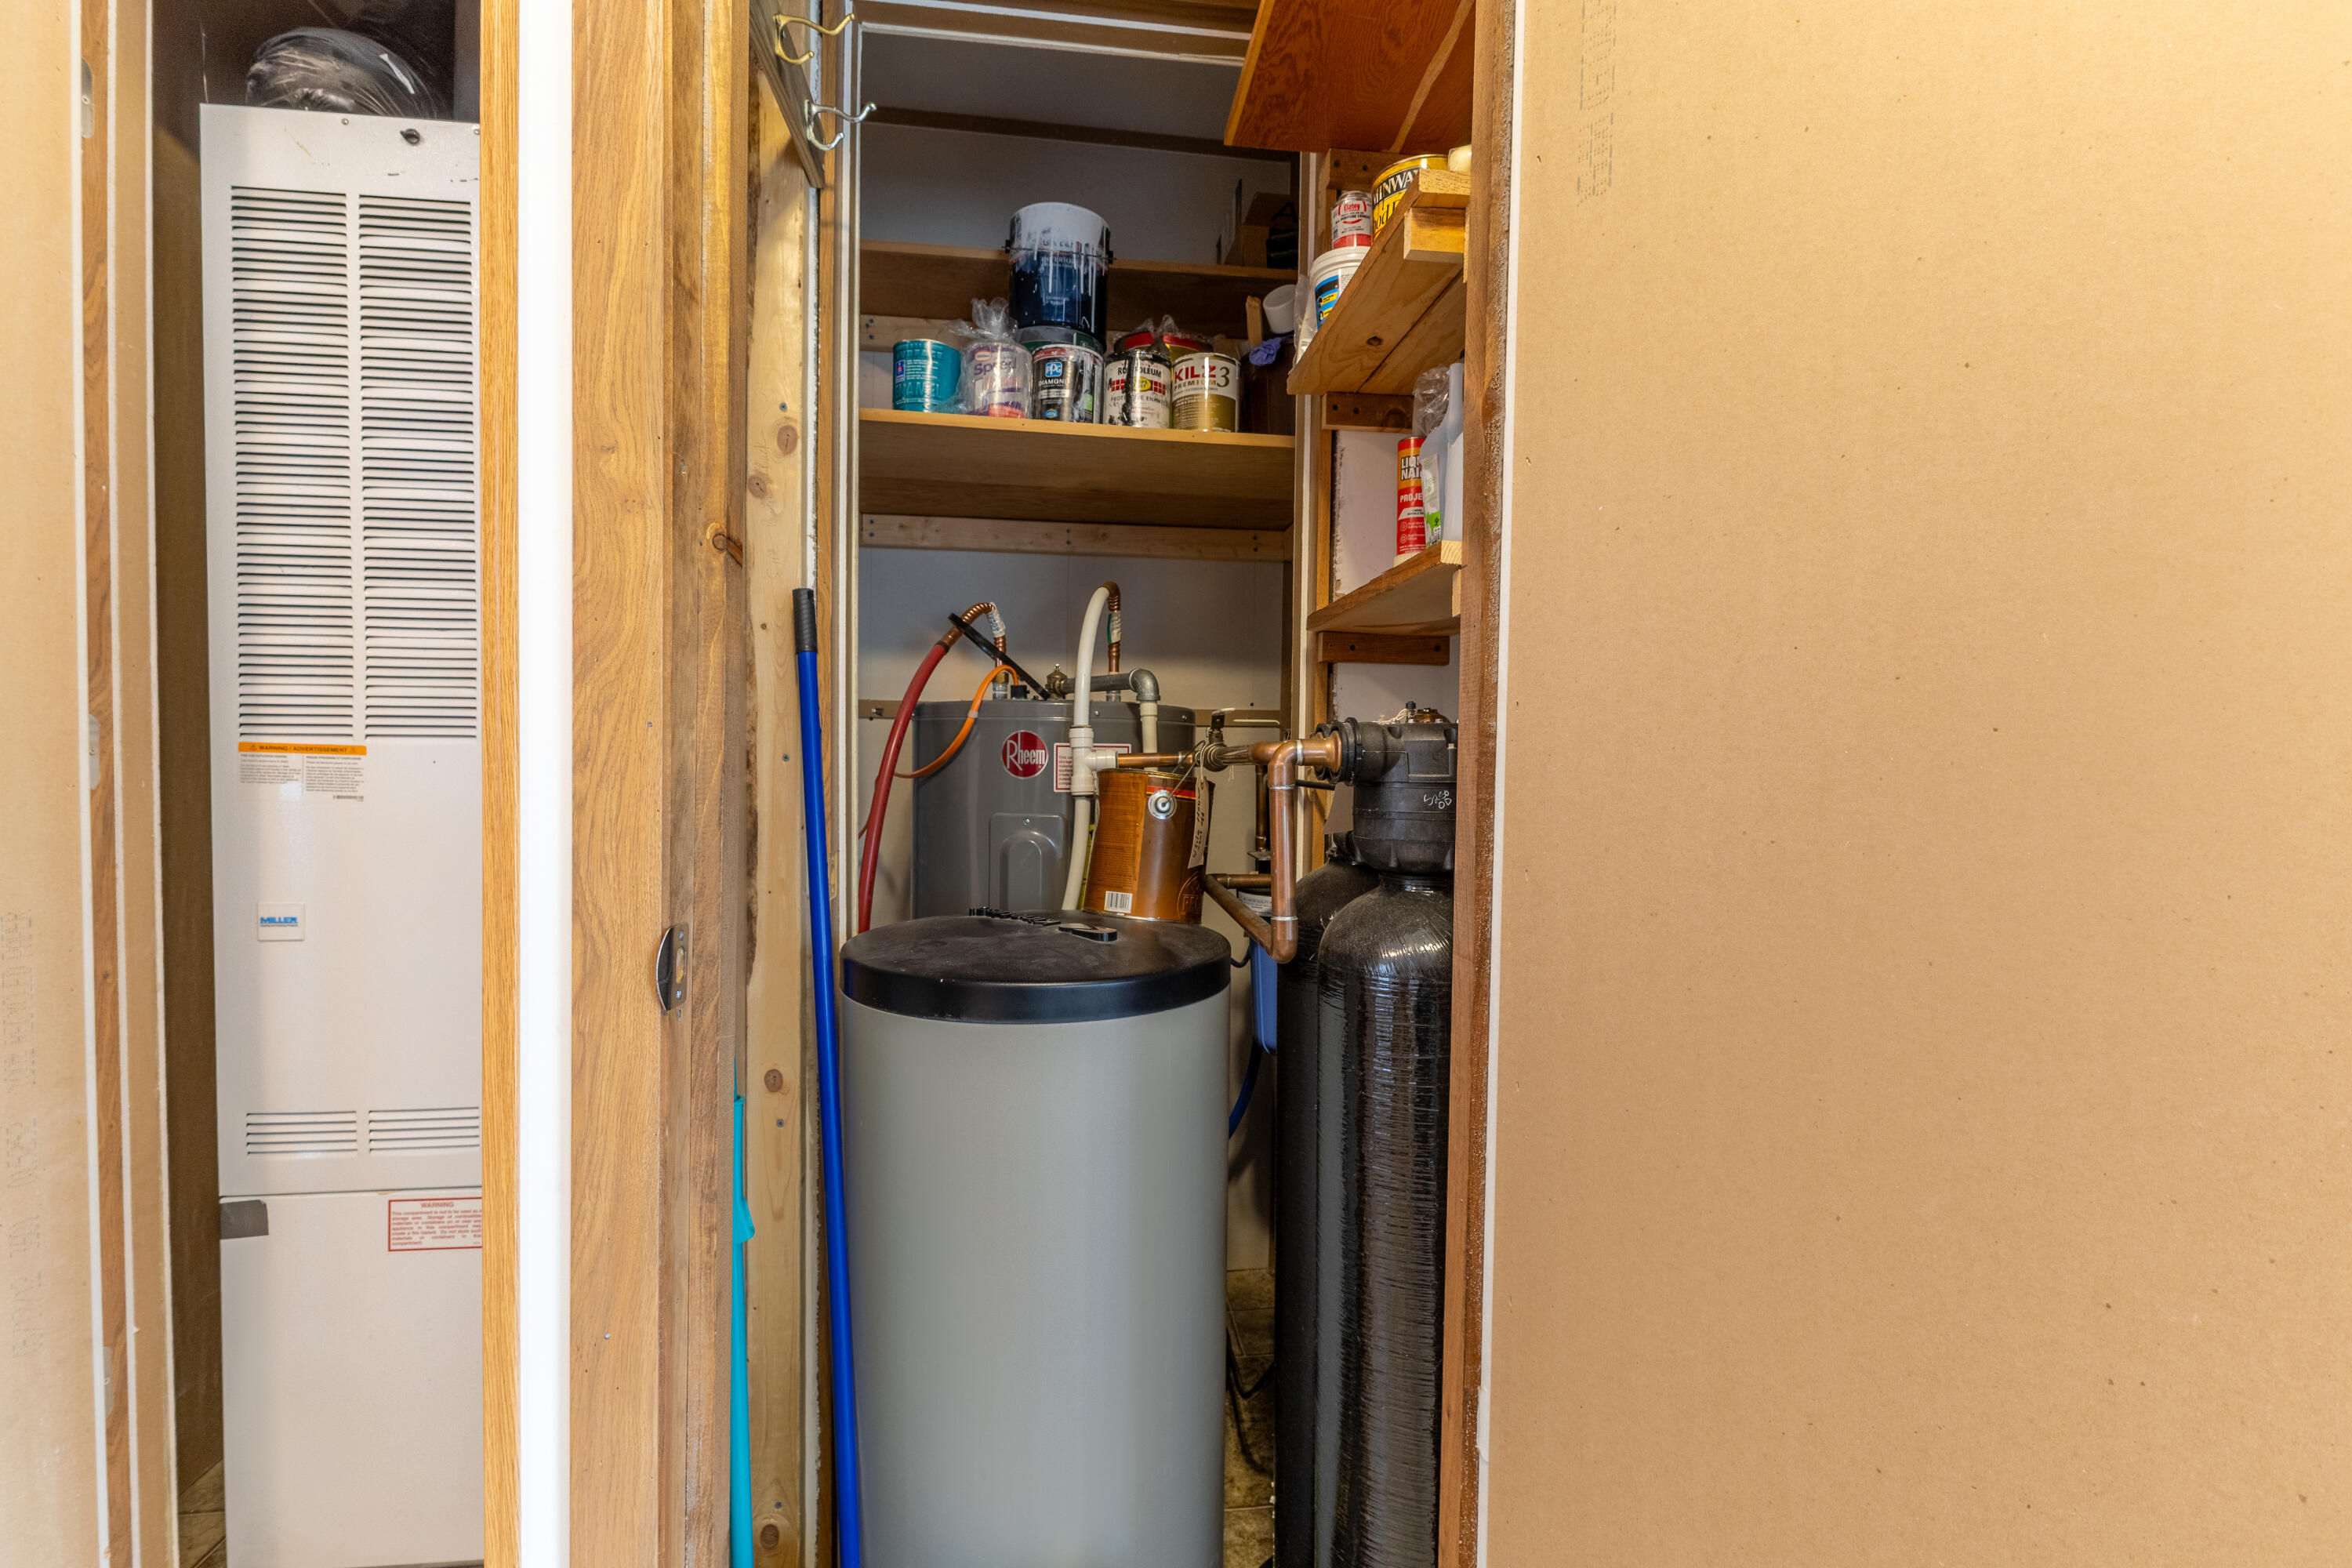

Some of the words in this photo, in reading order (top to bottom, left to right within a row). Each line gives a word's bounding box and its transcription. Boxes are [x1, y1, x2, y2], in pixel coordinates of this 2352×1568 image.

[1047, 363, 1062, 375] PPG
[1174, 365, 1217, 383] KILZ
[1217, 366, 1230, 387] 3
[1401, 455, 1419, 469] LIQ
[1401, 466, 1421, 481] NAI
[1399, 492, 1424, 503] PROJE
[1006, 732, 1046, 771] Rheem
